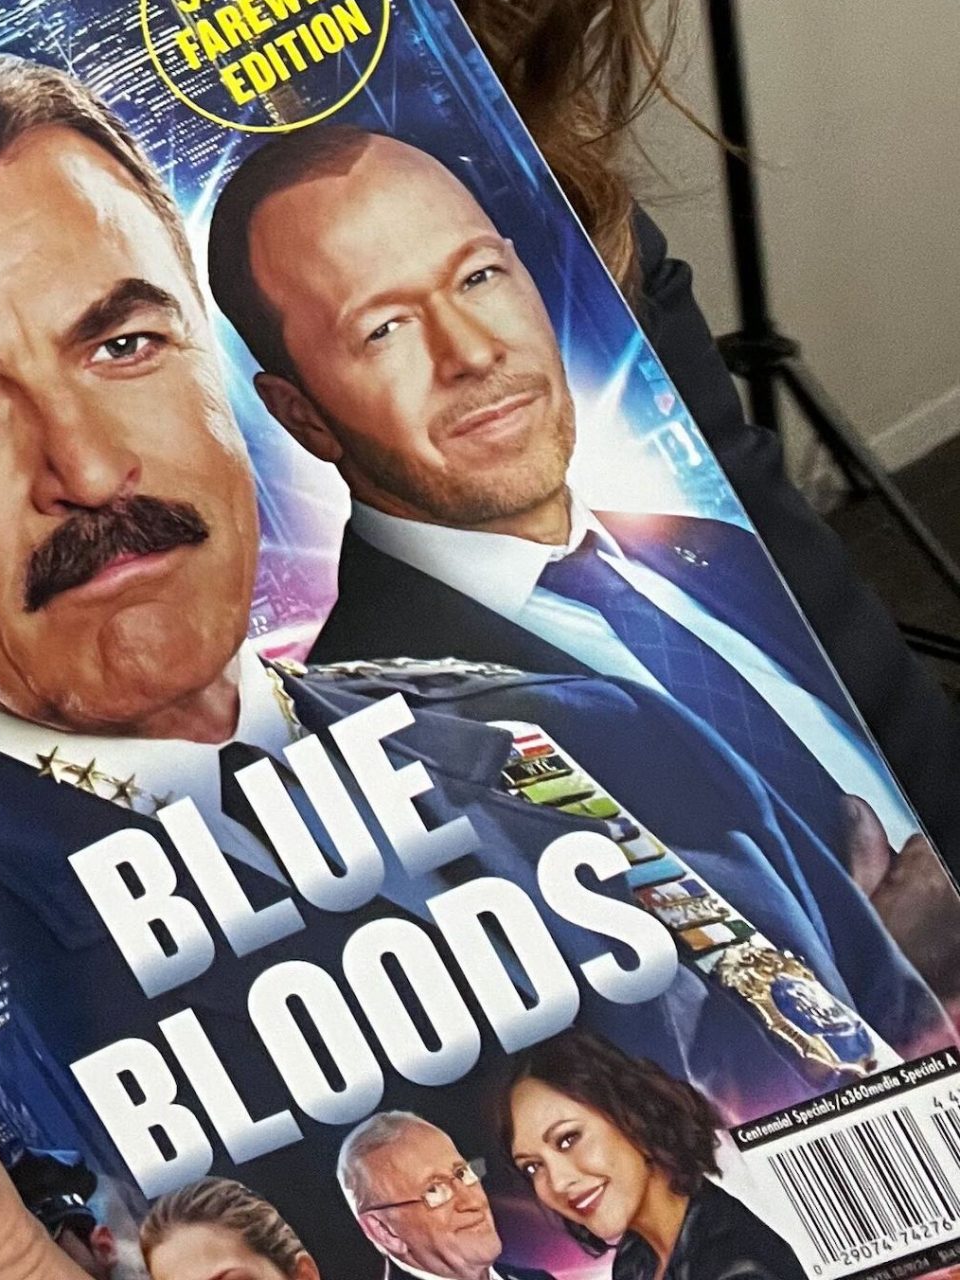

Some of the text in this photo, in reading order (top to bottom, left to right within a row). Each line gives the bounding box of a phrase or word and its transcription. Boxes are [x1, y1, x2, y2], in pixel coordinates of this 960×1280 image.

[67, 692, 482, 999] BLUE
[69, 831, 678, 1199] BLOODS
[737, 1112, 793, 1143] Centennial
[899, 1056, 946, 1084] Specials
[840, 1239, 893, 1266] 29074
